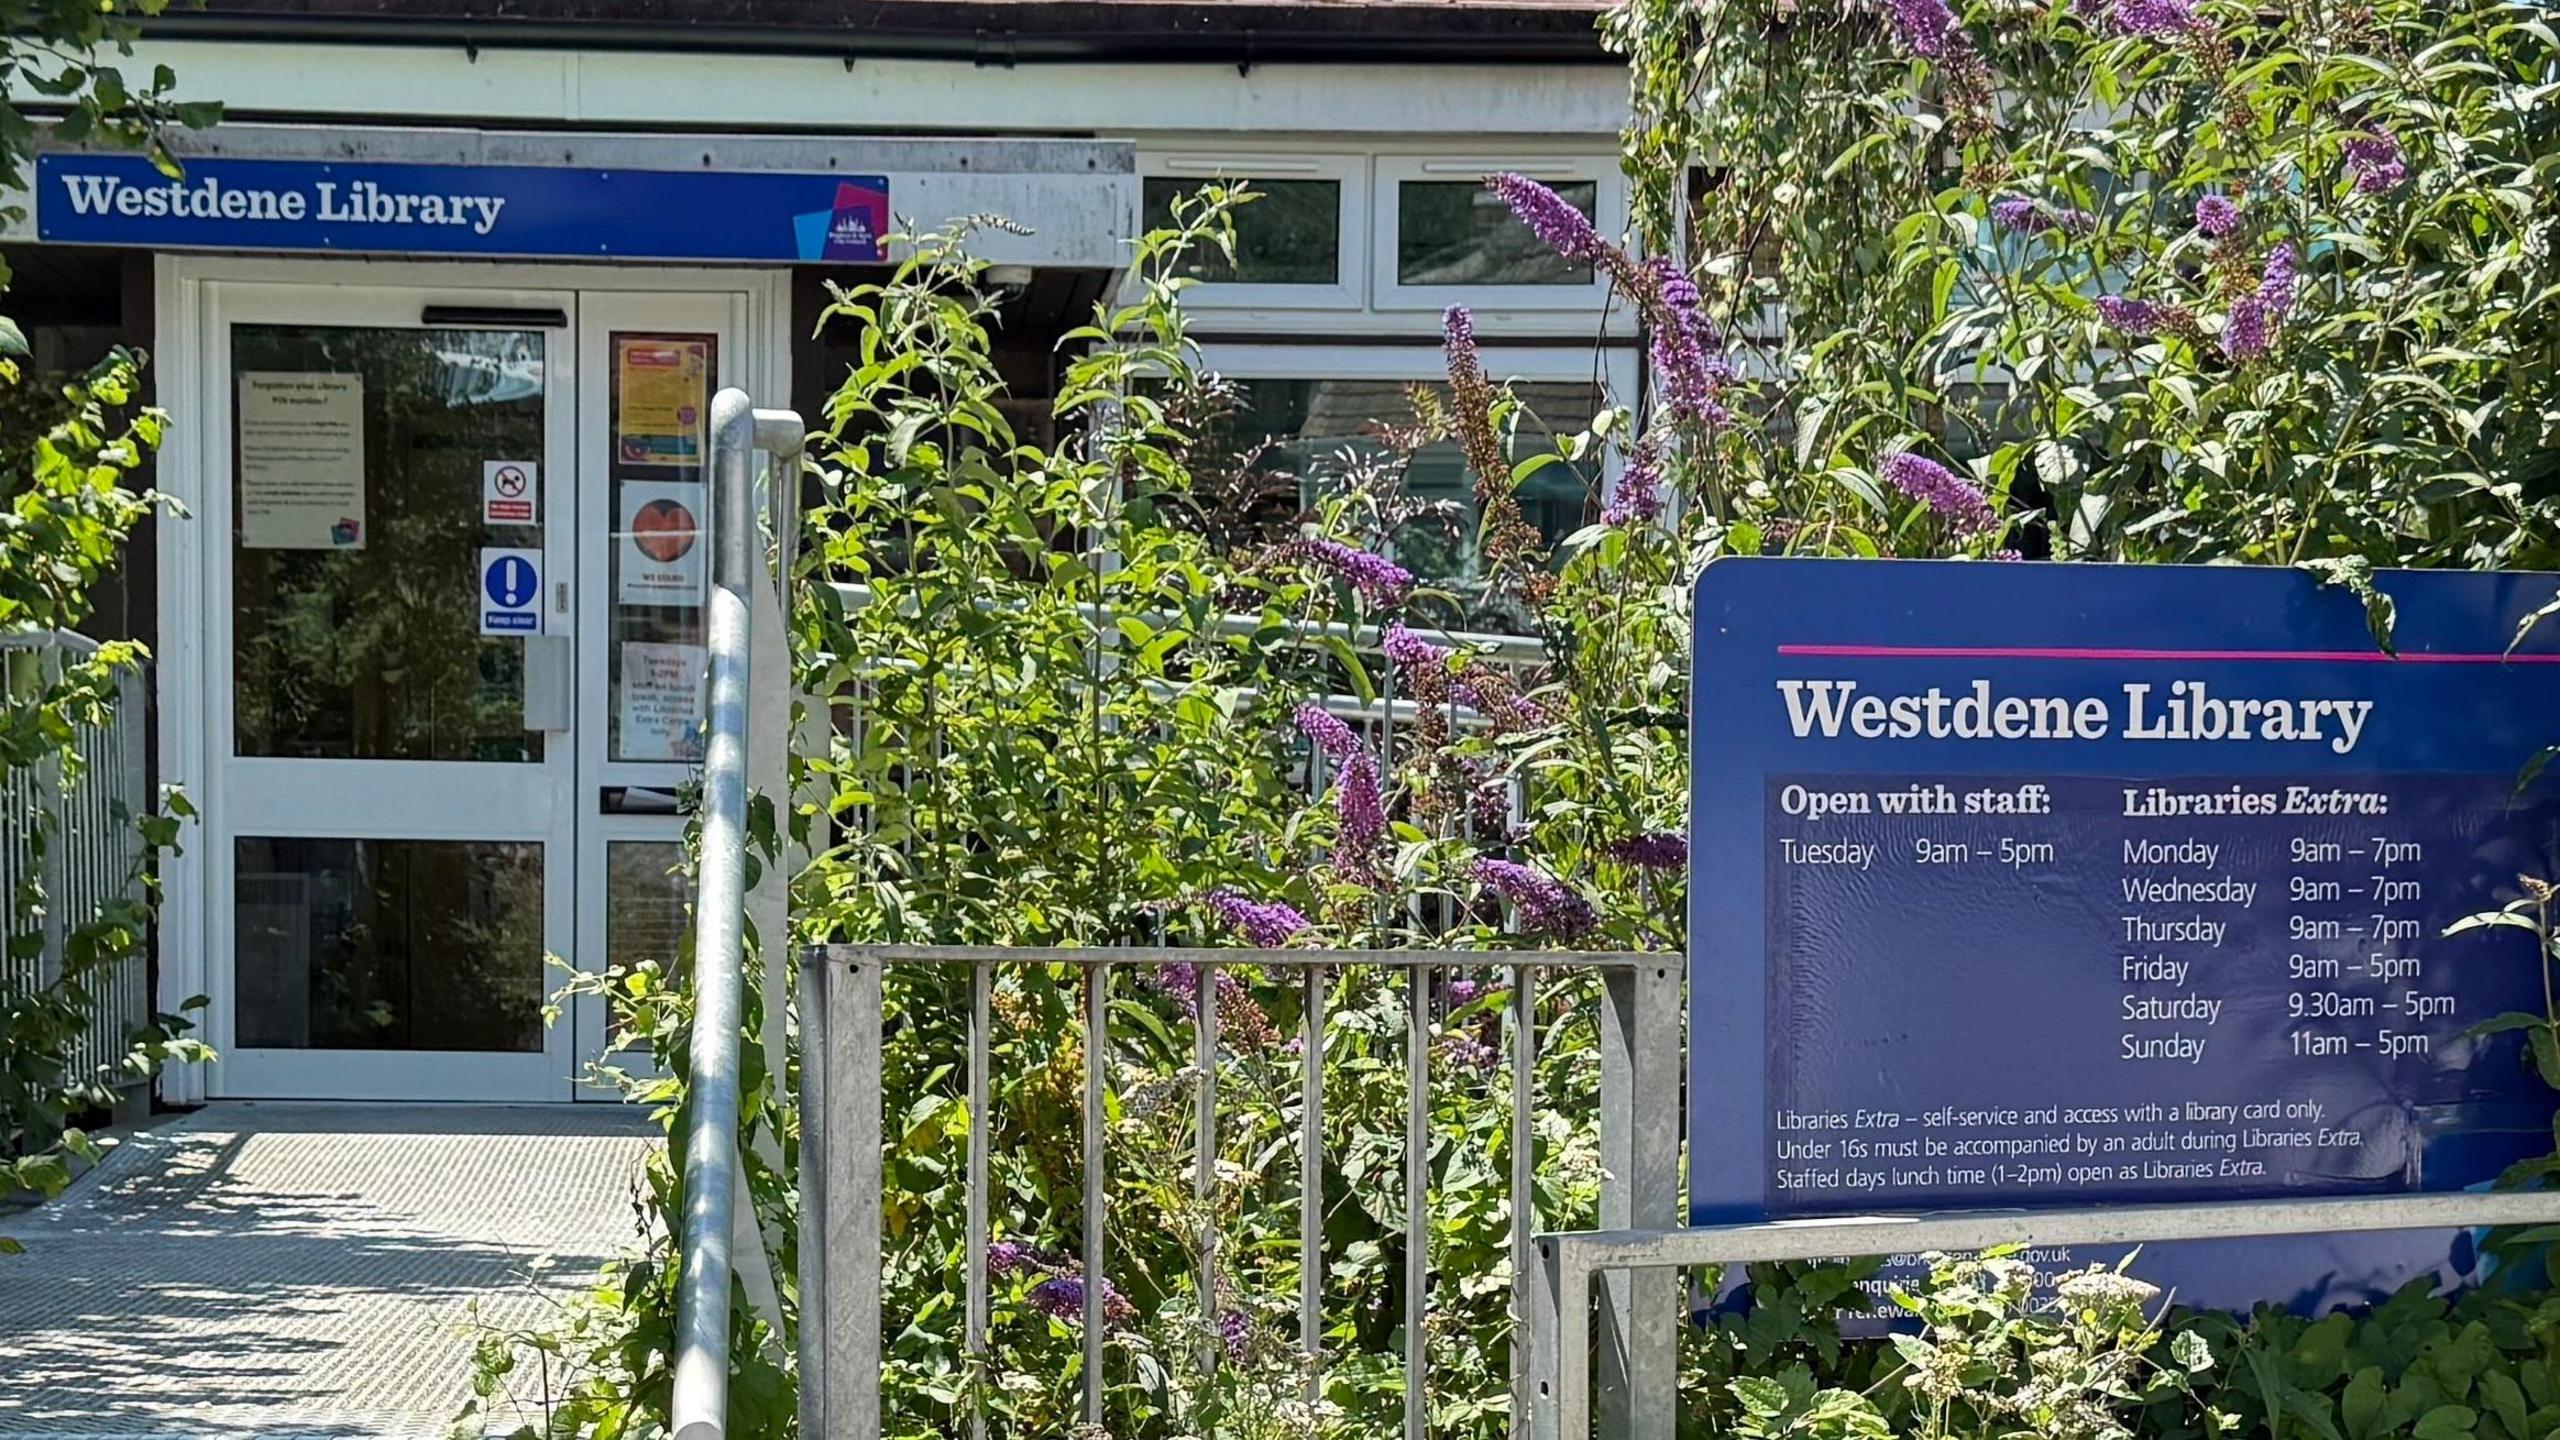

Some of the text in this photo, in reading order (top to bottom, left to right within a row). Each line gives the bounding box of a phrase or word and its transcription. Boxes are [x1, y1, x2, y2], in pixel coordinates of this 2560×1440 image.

[62, 174, 505, 234] Westdene Library
[488, 615, 534, 626] Keep clear
[1777, 680, 2372, 753] Westdene Library
[1782, 784, 2049, 820] Open with staff:
[2124, 785, 2387, 816] Libraries Extra:
[1780, 837, 1874, 870] Tuesday
[1917, 839, 1967, 863] 9am
[2002, 838, 2053, 869] 5pm
[2124, 838, 2218, 869] Monday
[2291, 838, 2340, 862] 9am
[2372, 838, 2420, 868] 7pm
[2122, 876, 2256, 908] Wednesday
[2291, 877, 2339, 901] 9am
[2372, 876, 2419, 906] 7pm
[2122, 915, 2225, 947] Thursday
[2290, 916, 2338, 939] 9am
[2372, 915, 2419, 945] 7pm
[2124, 954, 2188, 986] Friday
[2290, 954, 2338, 978] 9am
[2370, 953, 2419, 983] 5pm
[2123, 993, 2221, 1025] Saturday
[2289, 992, 2373, 1017] 9.30am
[2406, 991, 2454, 1021] 5pm
[2122, 1032, 2205, 1064] Sunday
[2292, 1031, 2346, 1055] 11am
[2380, 1030, 2428, 1059] 5pm
[1778, 1111, 1848, 1129] Libraries
[1855, 1110, 1899, 1128] Extra
[1924, 1106, 2017, 1127] self-service
[2025, 1105, 2056, 1124] and
[2064, 1109, 2118, 1123] access
[2124, 1103, 2162, 1121] with
[2169, 1108, 2178, 1121] a
[2186, 1102, 2237, 1124] library
[2244, 1100, 2280, 1119] card
[2287, 1099, 2324, 1123] only.
[1778, 1128, 2363, 1159] Under 16s must be accompanied by an adult during Libraries Extra.
[1778, 1159, 2266, 1191] Staffed days lunch time (1–2pm) open as Libraries Extra.
